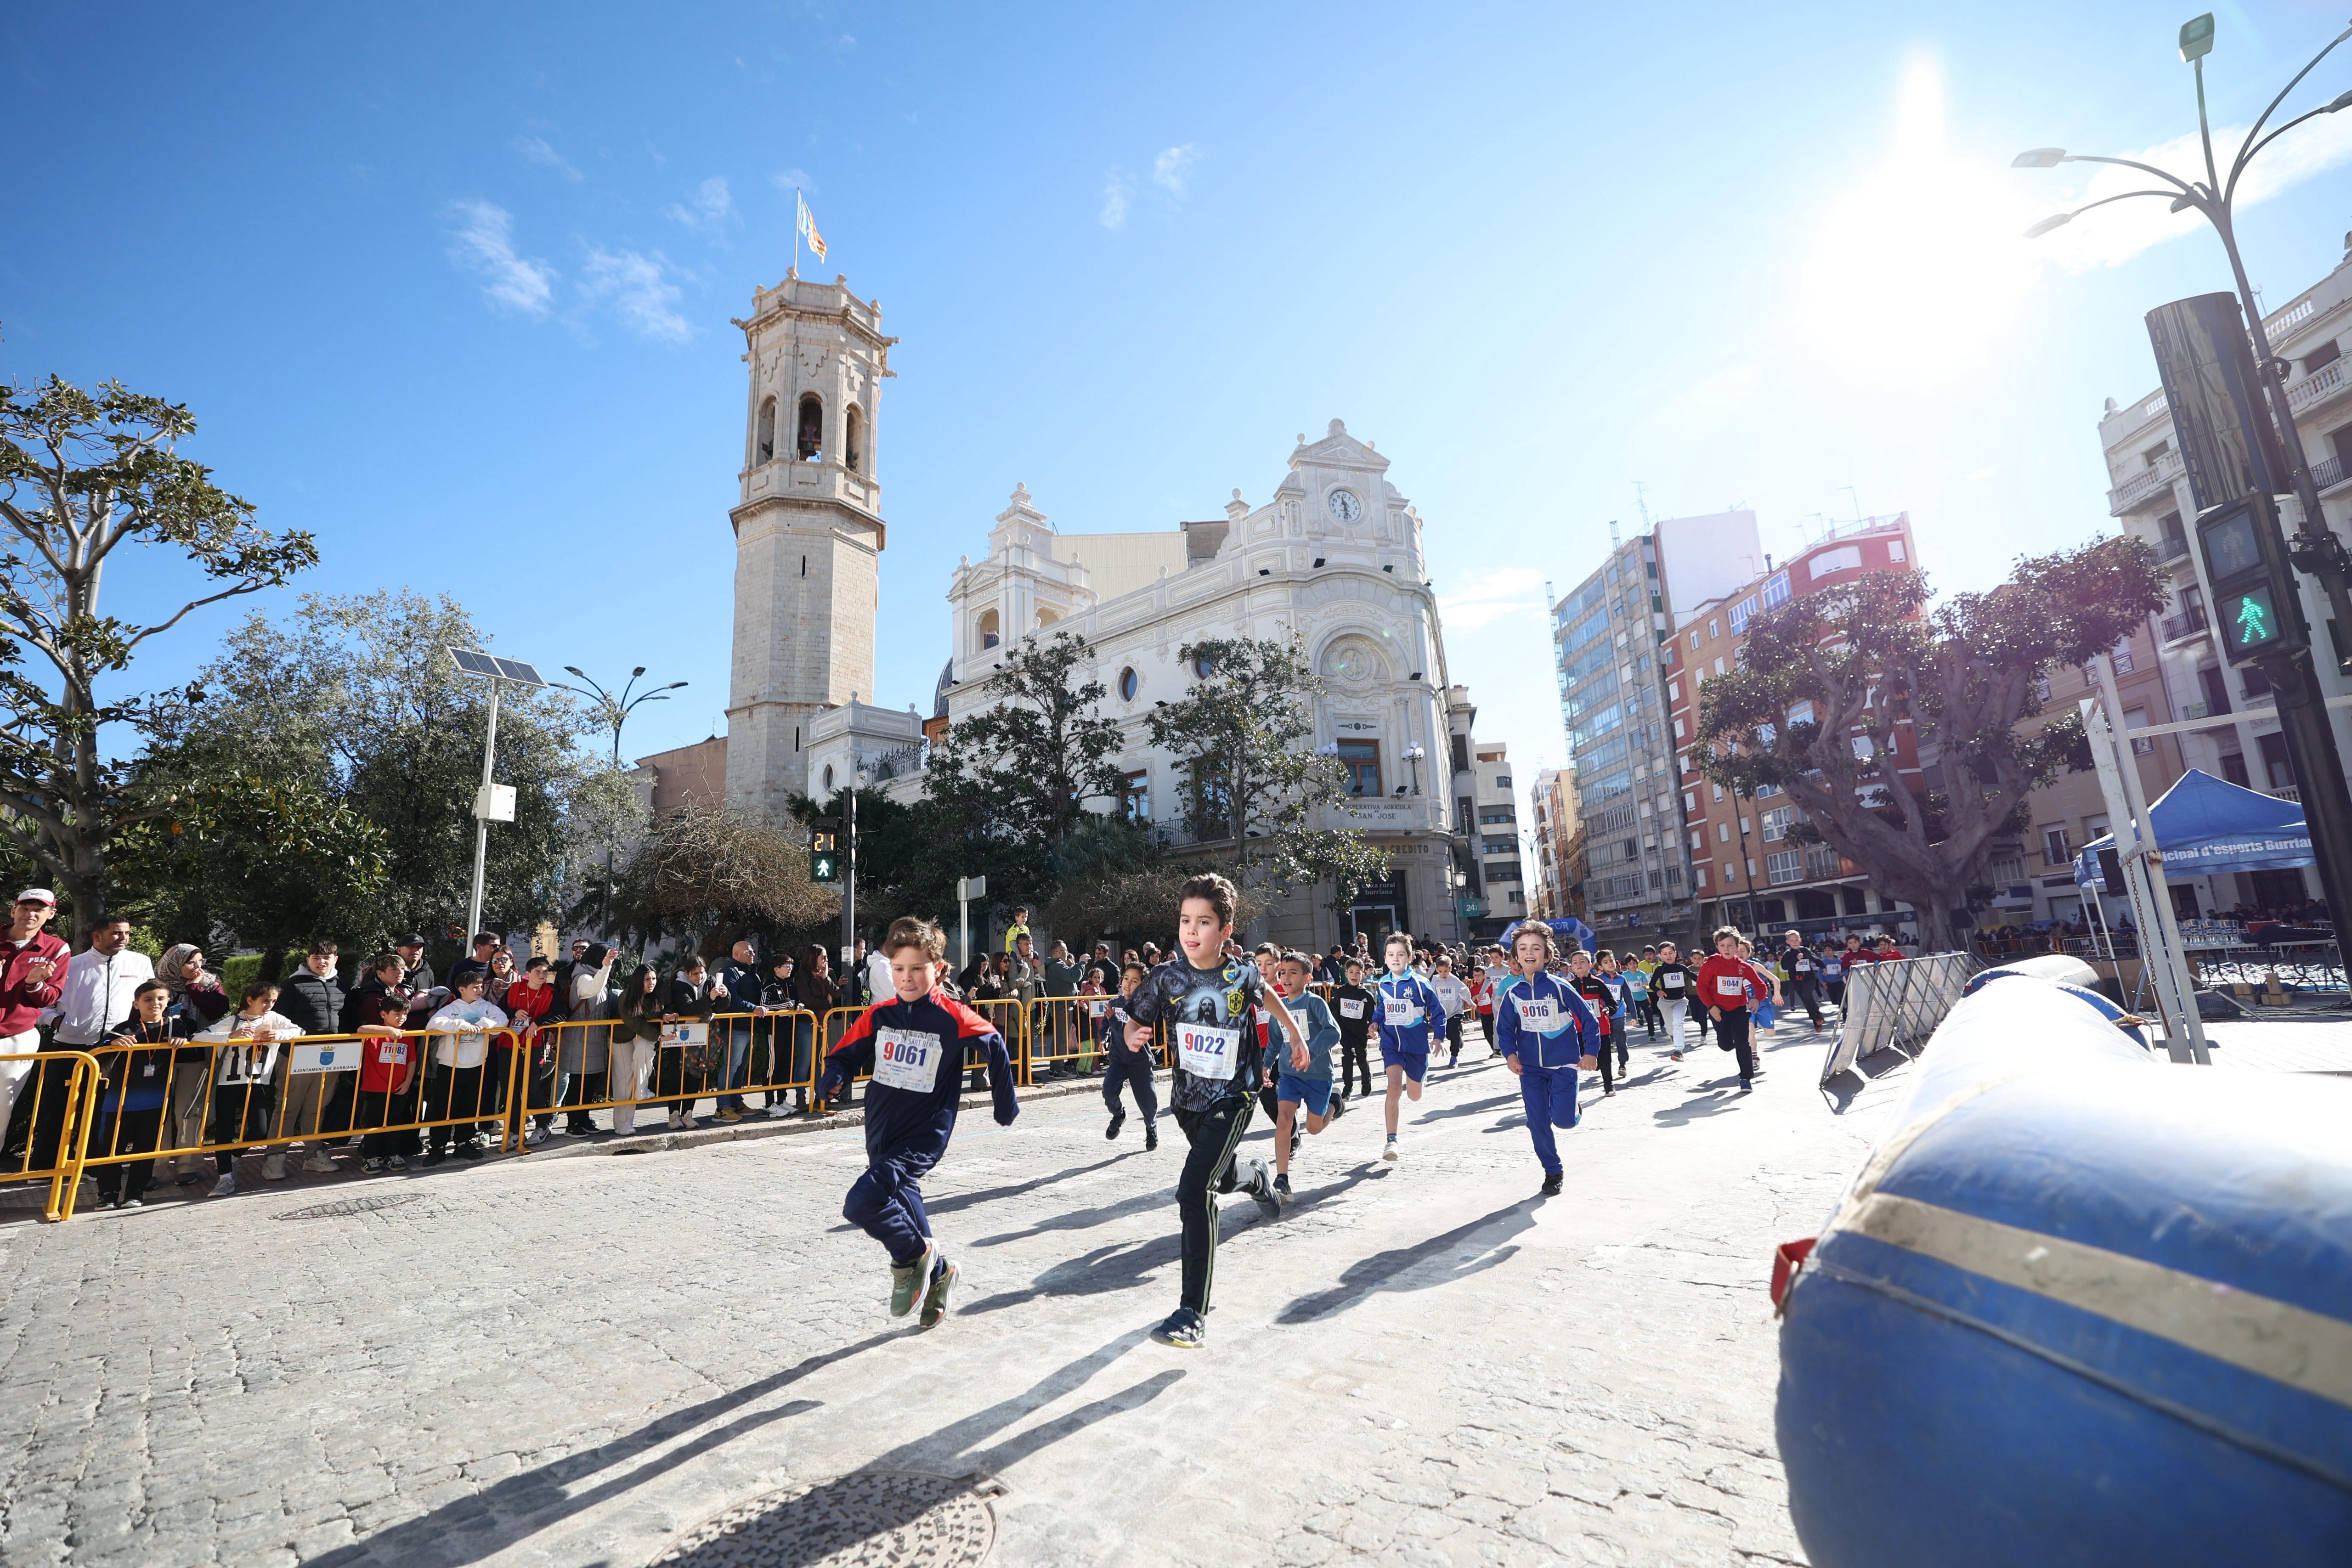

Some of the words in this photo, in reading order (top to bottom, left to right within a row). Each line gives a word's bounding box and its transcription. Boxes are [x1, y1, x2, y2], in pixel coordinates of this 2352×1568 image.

[814, 833, 834, 852] 21
[1390, 845, 1429, 854] CREDITO
[2201, 842, 2264, 857] d'esports
[1344, 1002, 1359, 1010] 9062
[1387, 1004, 1406, 1013] 9009
[1522, 1005, 1549, 1017] 9016
[885, 1033, 899, 1042] CURSA
[1185, 1032, 1225, 1055] 9022
[883, 1041, 927, 1066] 9061
[226, 1045, 269, 1081] 10
